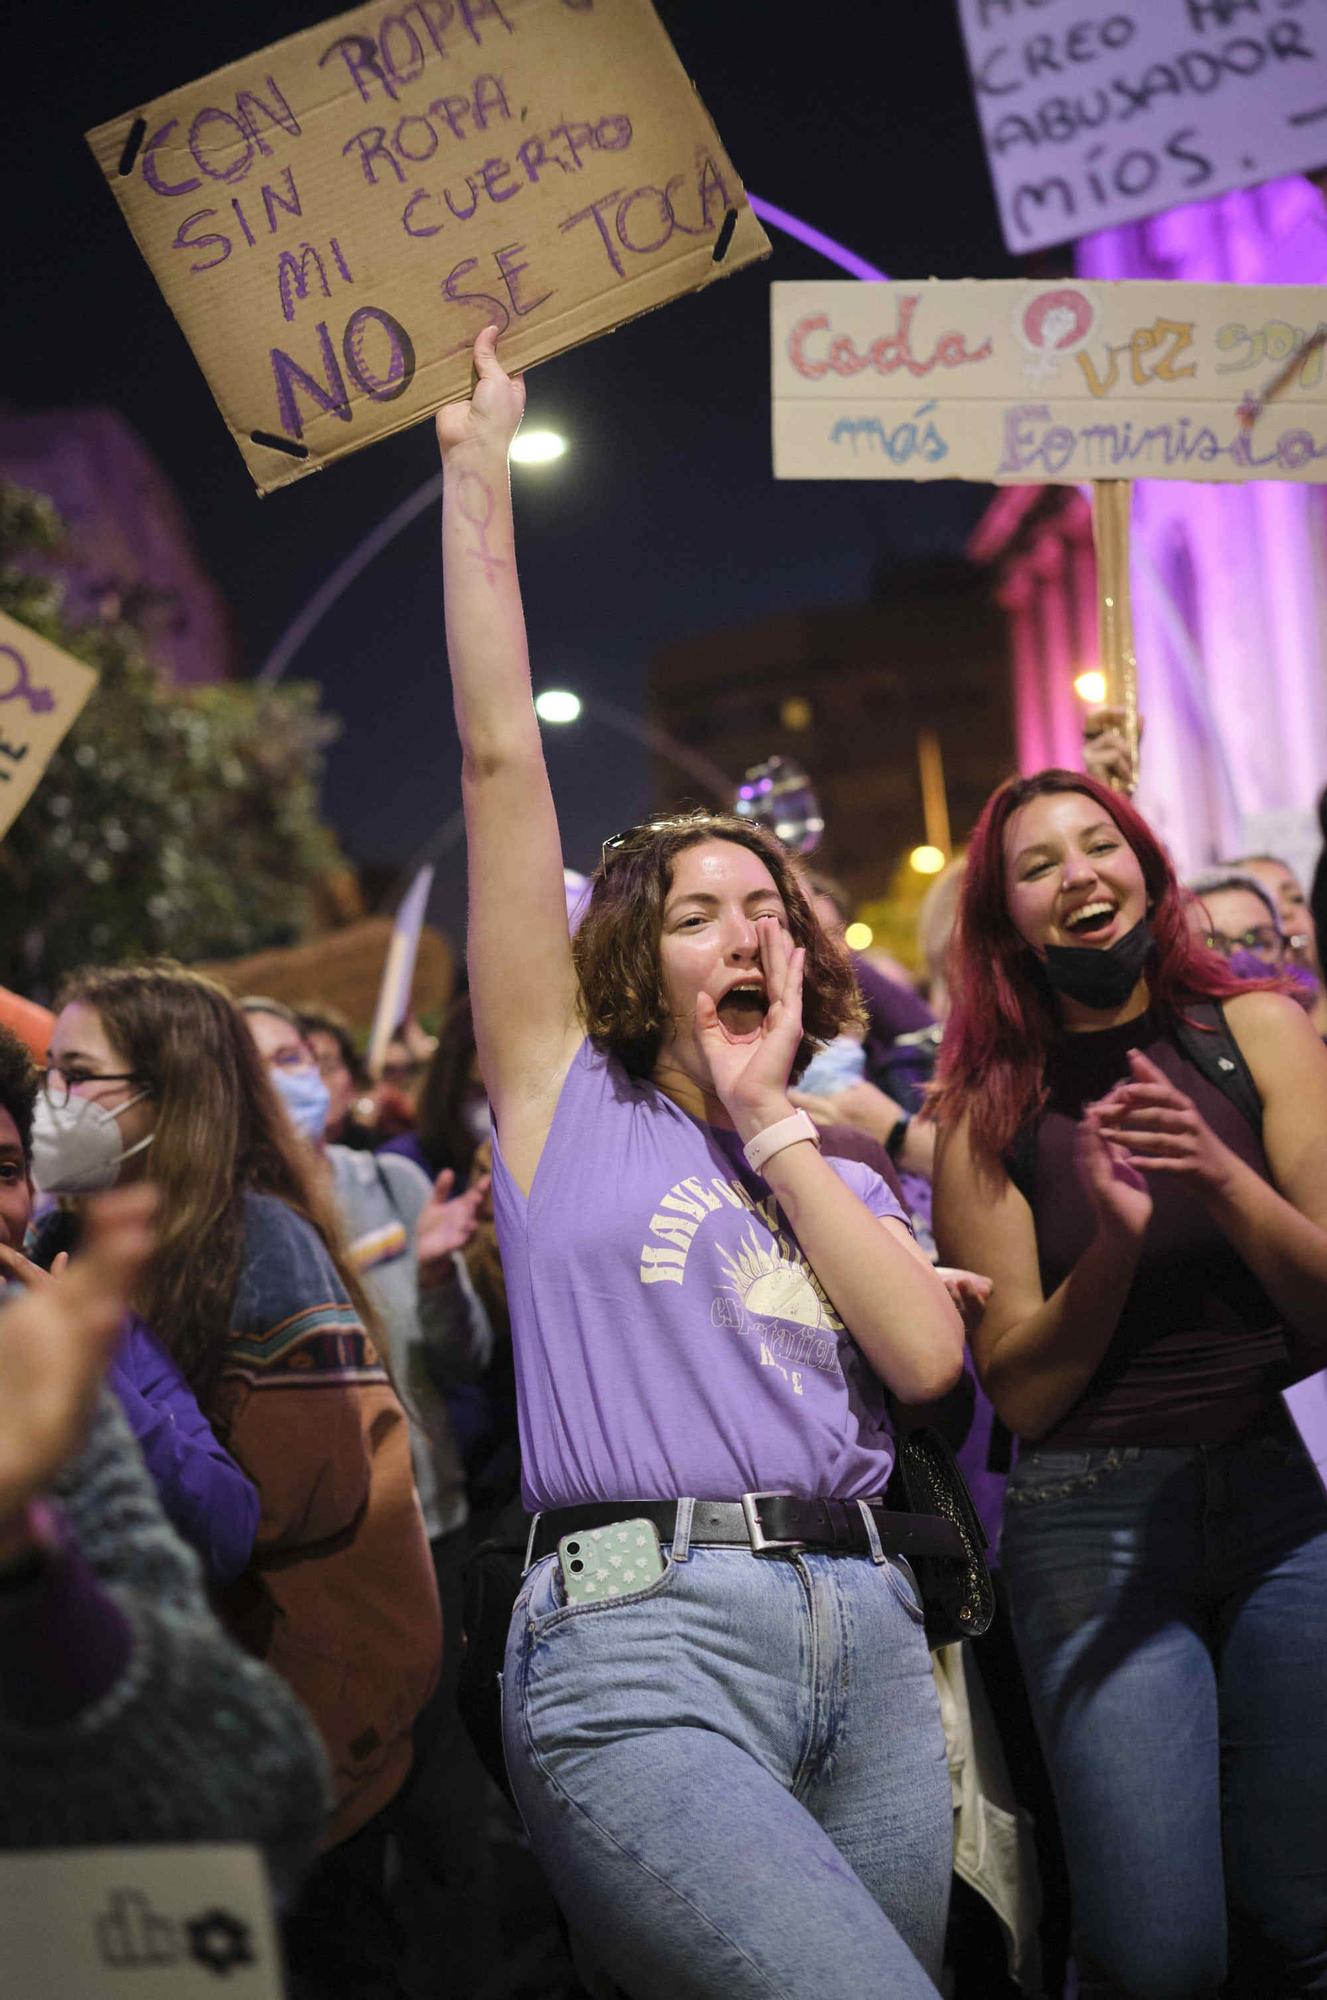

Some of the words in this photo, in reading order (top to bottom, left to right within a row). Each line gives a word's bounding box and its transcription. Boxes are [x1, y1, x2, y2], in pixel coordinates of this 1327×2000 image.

[977, 15, 1135, 95] CREO
[993, 19, 1314, 154] ABUSADOR
[142, 75, 300, 197] CON
[171, 166, 301, 271] SIN
[277, 237, 353, 321] MI
[401, 113, 632, 238] CUERPO
[270, 305, 415, 439] NO
[440, 242, 554, 353] SE
[558, 144, 731, 278] TOCA
[788, 293, 992, 380] Cada
